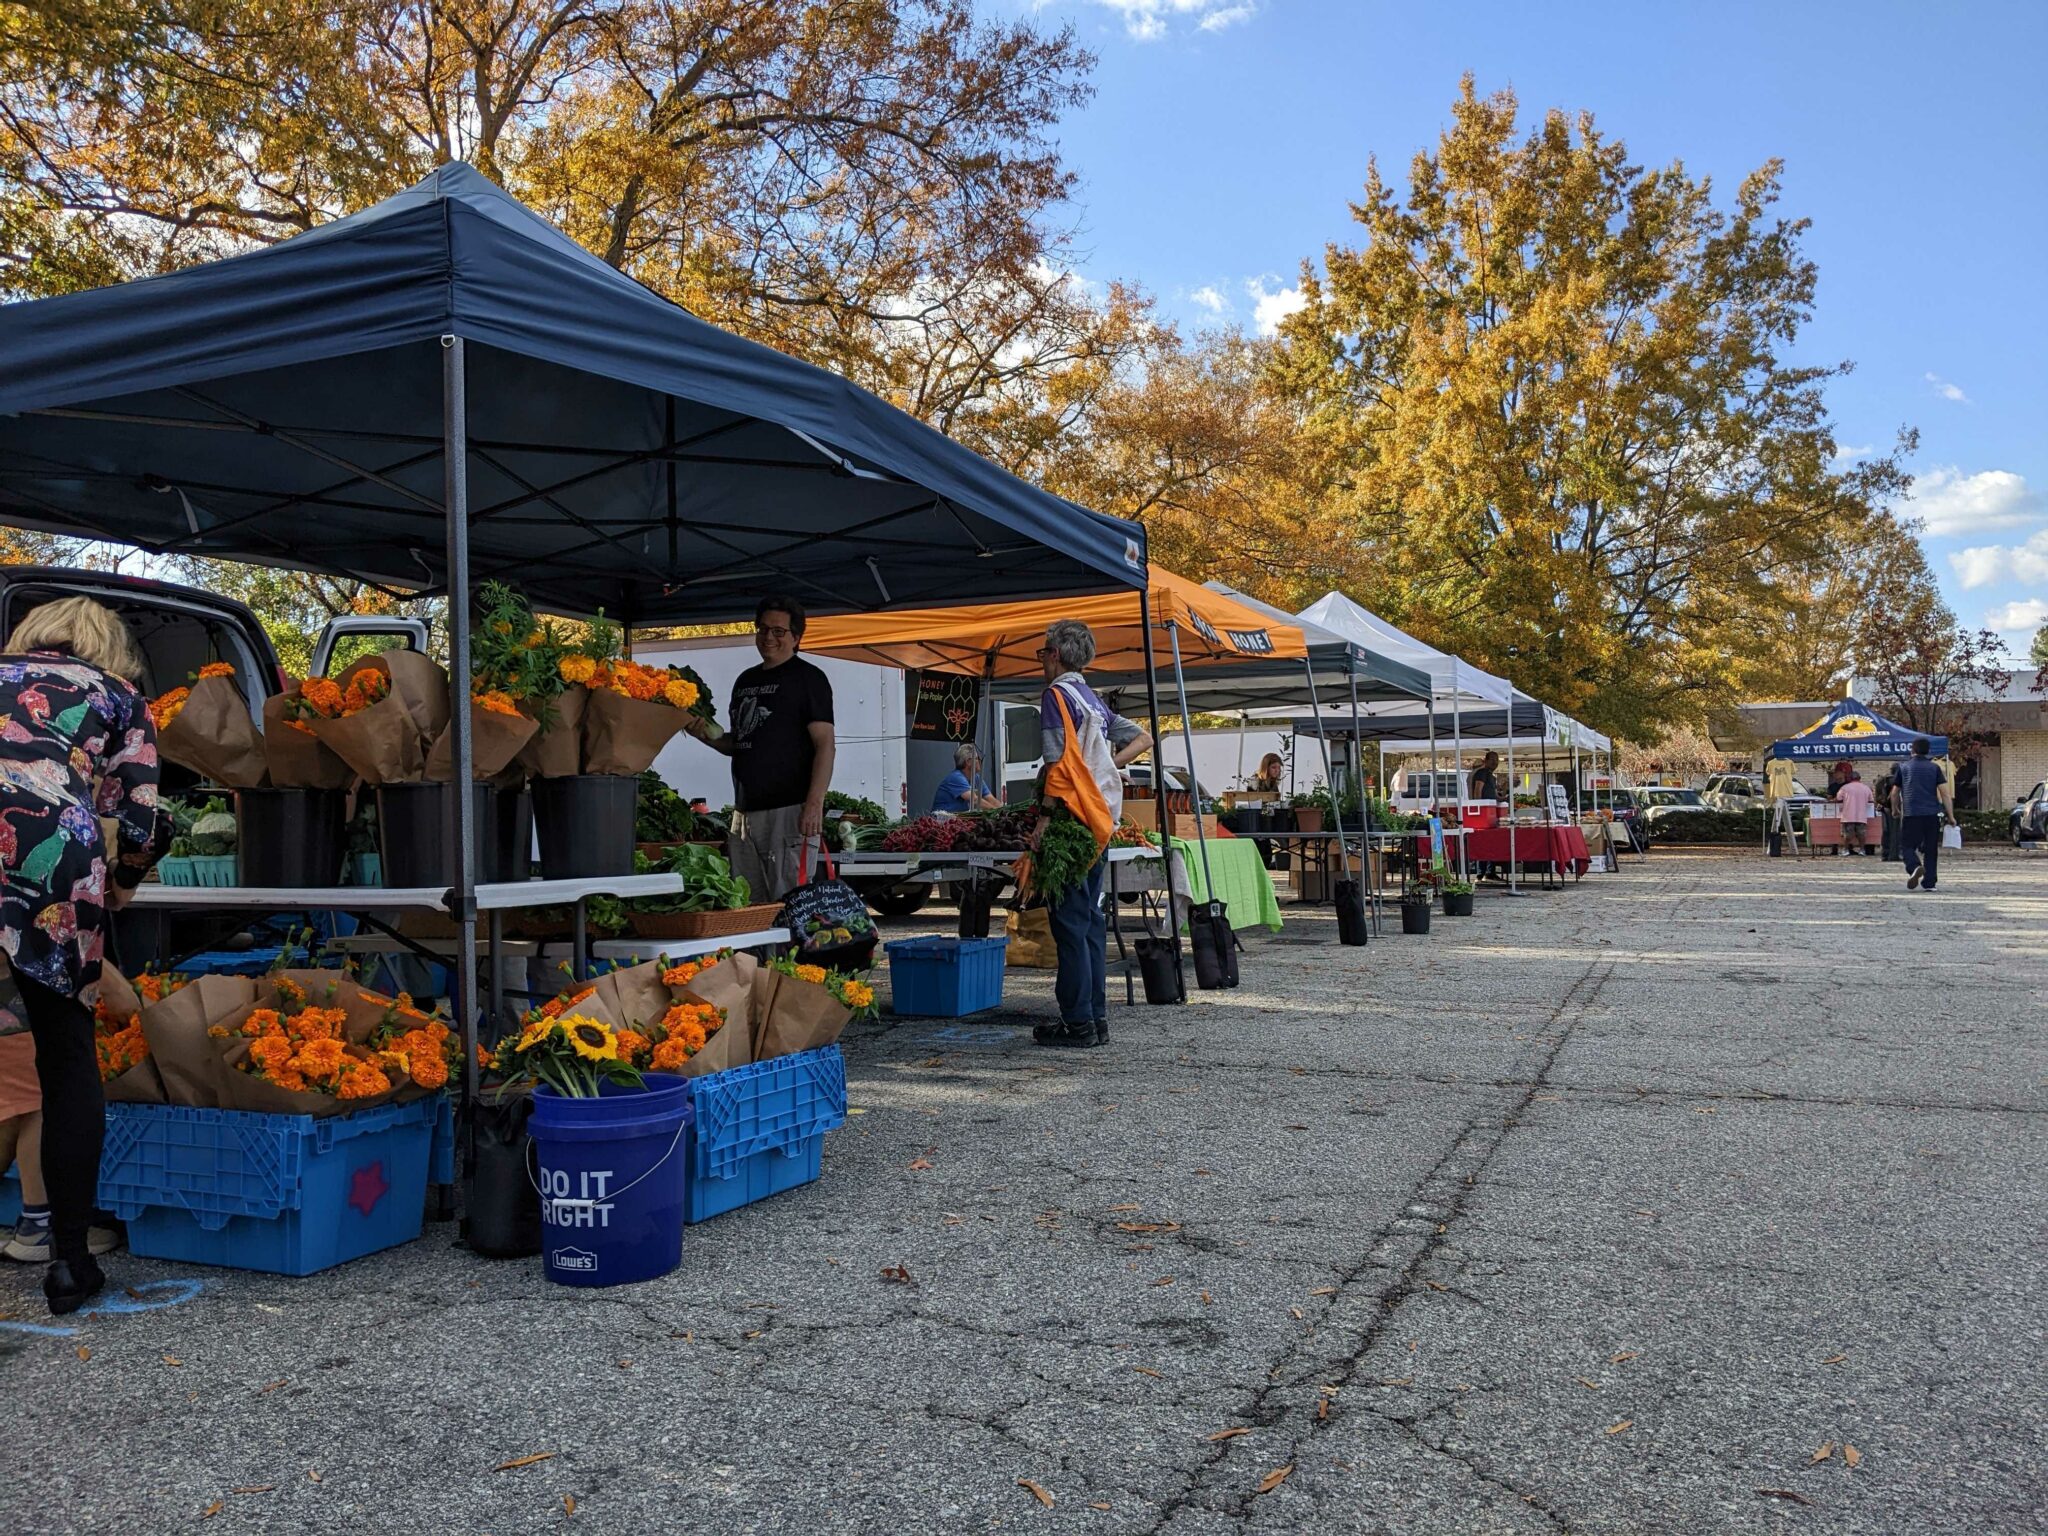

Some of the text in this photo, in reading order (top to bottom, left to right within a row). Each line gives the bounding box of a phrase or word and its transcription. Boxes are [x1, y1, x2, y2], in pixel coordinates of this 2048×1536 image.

[1229, 631, 1272, 650] HONEY
[920, 680, 945, 690] HONEY
[1793, 743, 1913, 754] SAY YES TO FRESH & LOC
[540, 1166, 613, 1199] DO IT
[542, 1201, 615, 1228] RIGHT
[555, 1253, 592, 1267] LOWE'S
